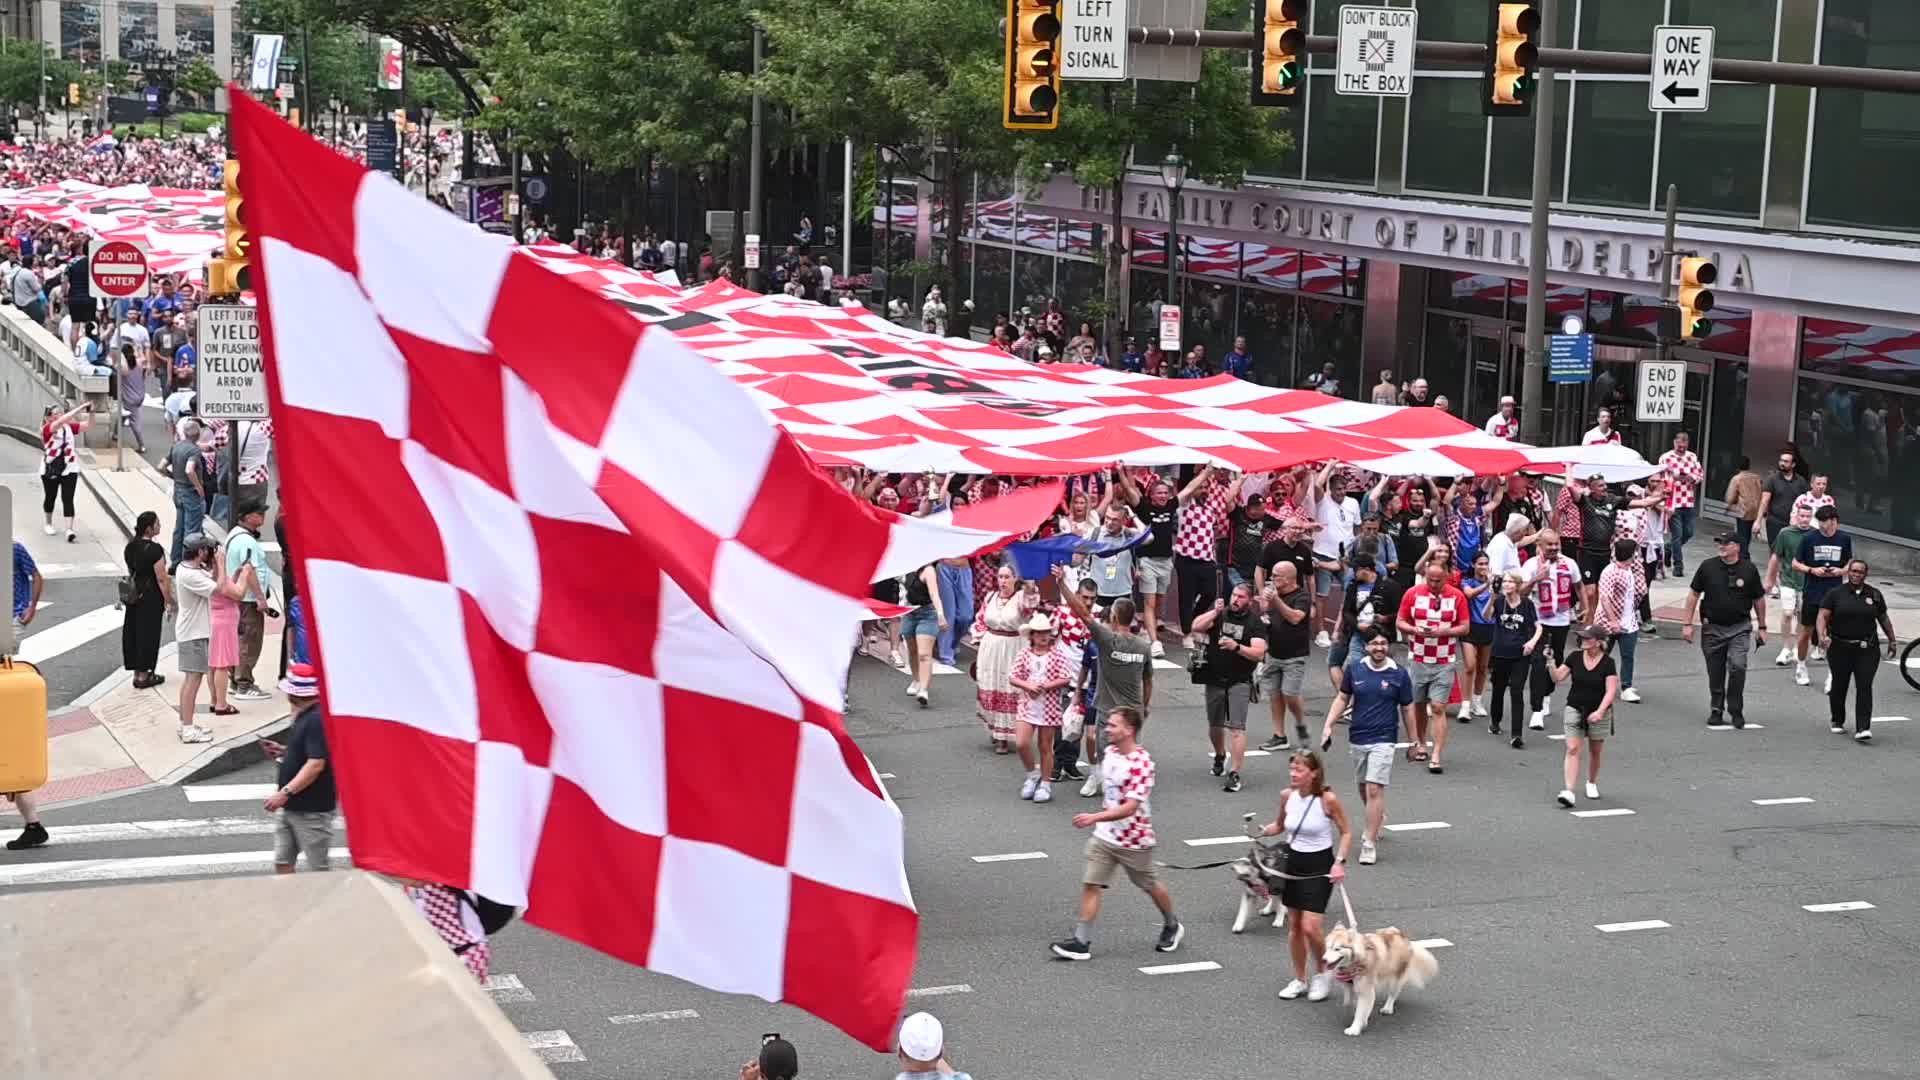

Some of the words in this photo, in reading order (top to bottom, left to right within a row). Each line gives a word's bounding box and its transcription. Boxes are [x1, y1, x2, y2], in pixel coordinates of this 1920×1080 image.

[1077, 1, 1112, 16] LEFT
[1345, 11, 1375, 25] DON'T
[1379, 12, 1411, 27] BLOCK
[1074, 25, 1112, 42] TURN
[1666, 36, 1701, 54] ONE
[1067, 51, 1119, 68] SIGNAL
[1664, 58, 1701, 76] WAY
[1344, 73, 1370, 90] THE
[1378, 75, 1406, 92] BOX
[1251, 202, 1353, 241] COURT
[1375, 216, 1418, 249] OF
[98, 251, 113, 261] DO
[117, 252, 138, 262] NOT
[102, 276, 136, 287] ENTER
[209, 310, 230, 321] LEFT
[211, 324, 260, 340] YIELD
[205, 343, 219, 354] ON
[204, 357, 265, 373] YELLOW
[216, 376, 253, 387] ARROW
[1648, 368, 1676, 382] END
[229, 390, 241, 401] TO
[1647, 385, 1676, 398] ONE
[205, 403, 265, 414] PEDESTRIANS
[1646, 401, 1675, 415] WAY
